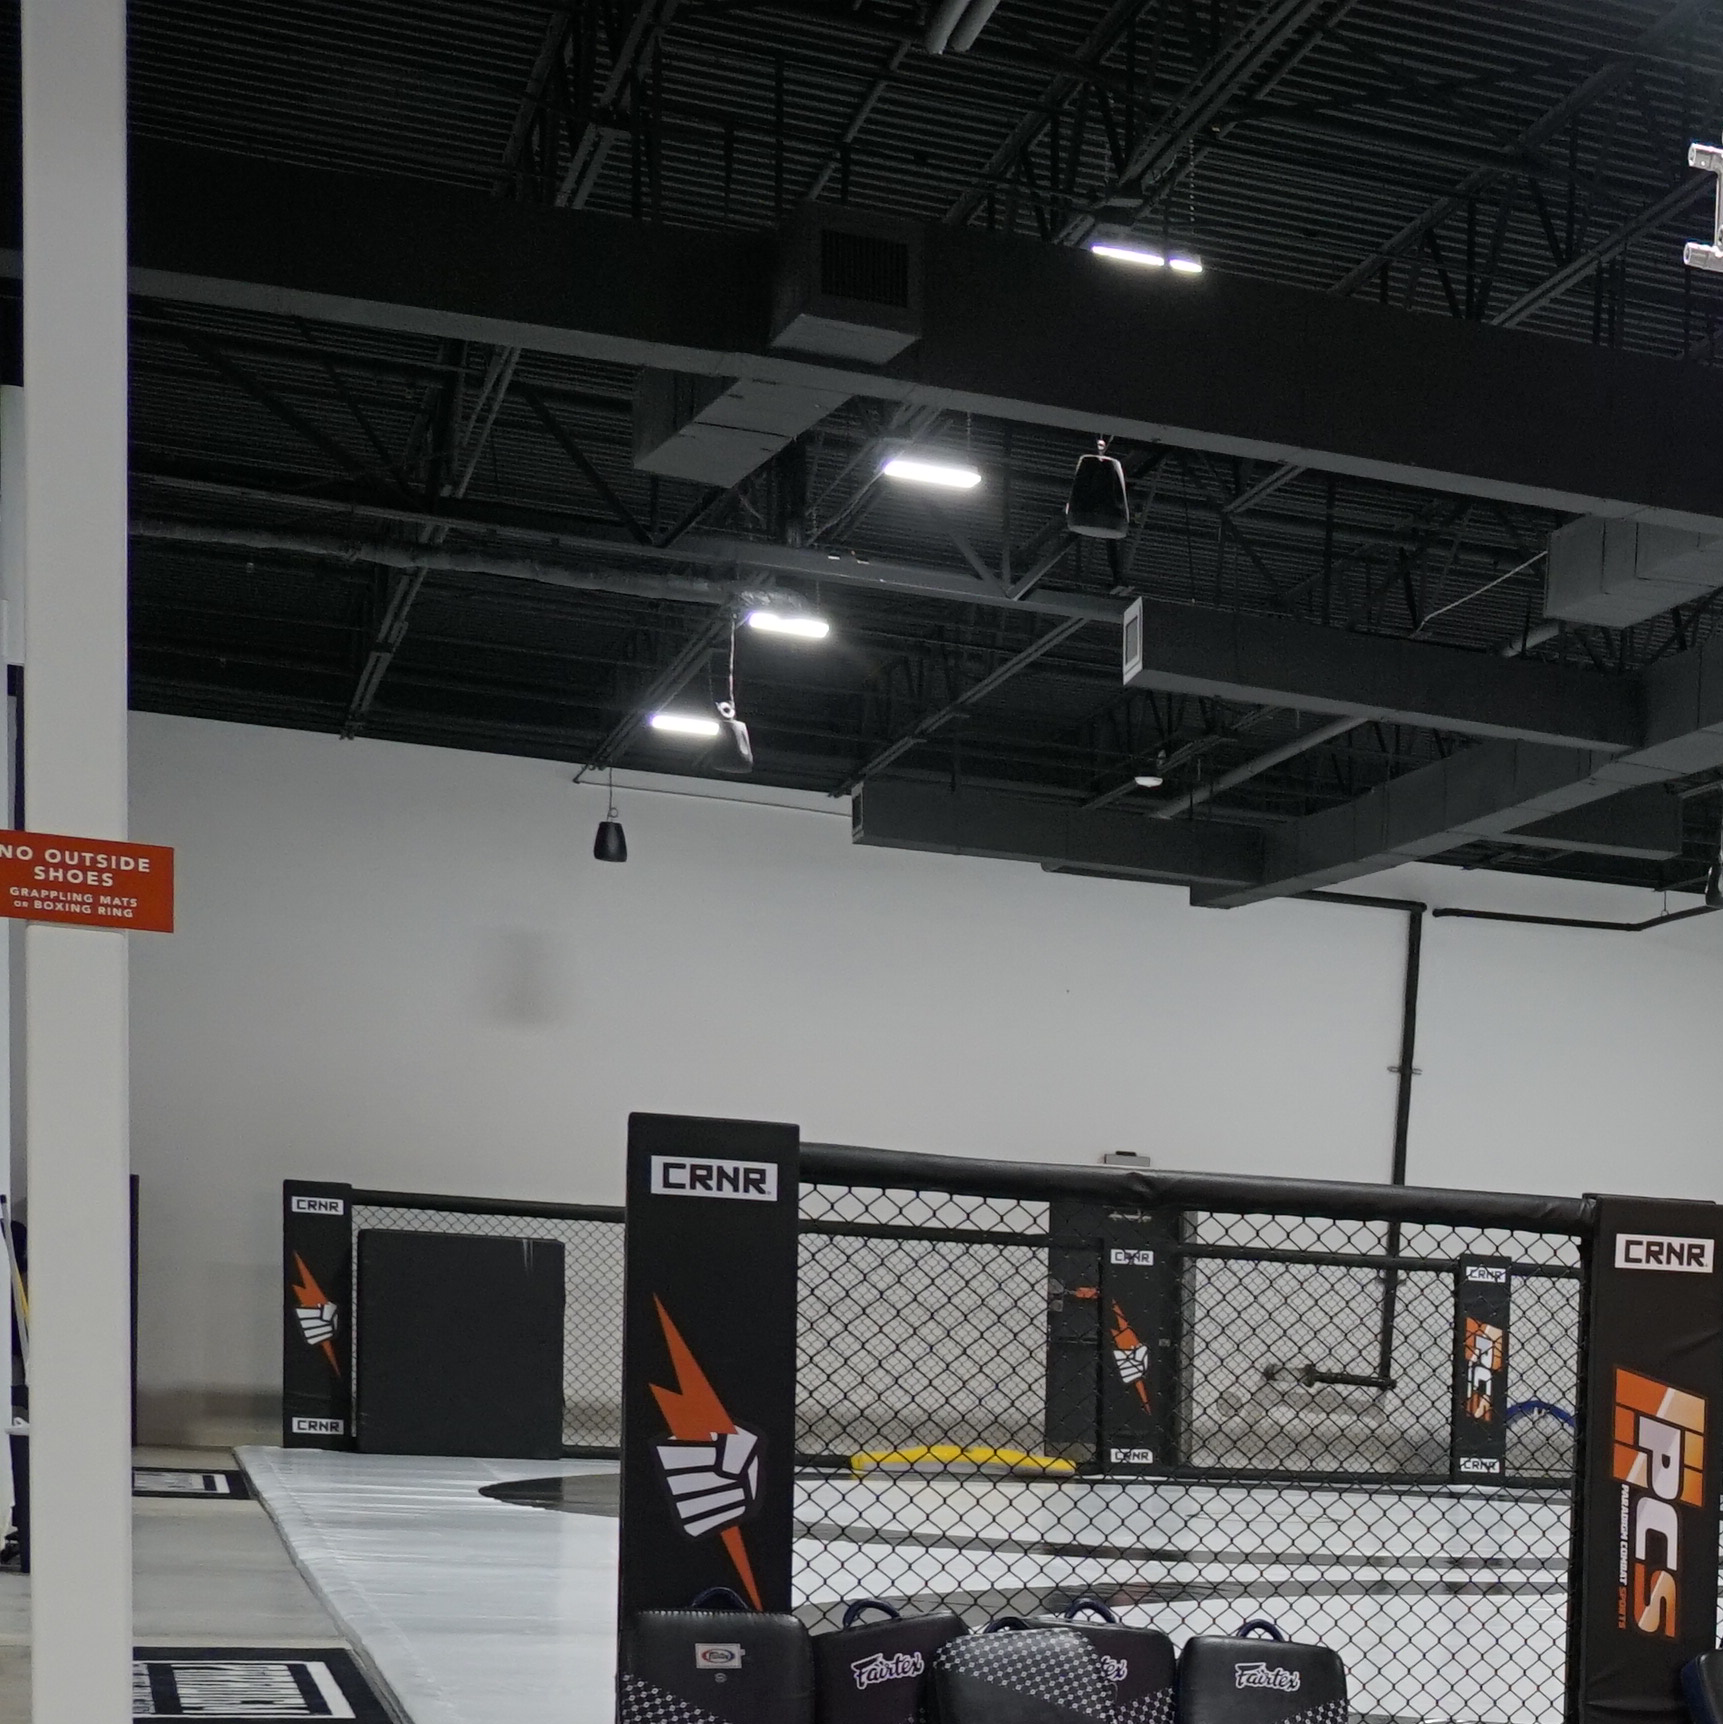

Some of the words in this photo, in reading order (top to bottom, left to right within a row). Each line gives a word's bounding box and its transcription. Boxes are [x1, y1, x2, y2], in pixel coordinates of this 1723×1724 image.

[0, 844, 33, 860] NO
[45, 849, 150, 872] OUTSIDE
[34, 866, 113, 887] SHOES
[10, 886, 93, 903] GRAPPLING
[100, 895, 137, 907] MATS
[34, 900, 91, 914] BOXING
[98, 907, 133, 918] RING
[663, 1162, 766, 1195] CRNR
[297, 1199, 339, 1212] CRNR
[1624, 1239, 1705, 1267] CRNR
[298, 1420, 340, 1432] CRNR
[1620, 1484, 1630, 1539] PARADIGM
[1632, 1415, 1682, 1639] PCS
[1619, 1541, 1628, 1585] COMBAT
[851, 1652, 925, 1690] Fairtex
[1235, 1662, 1301, 1692] Fairtex
